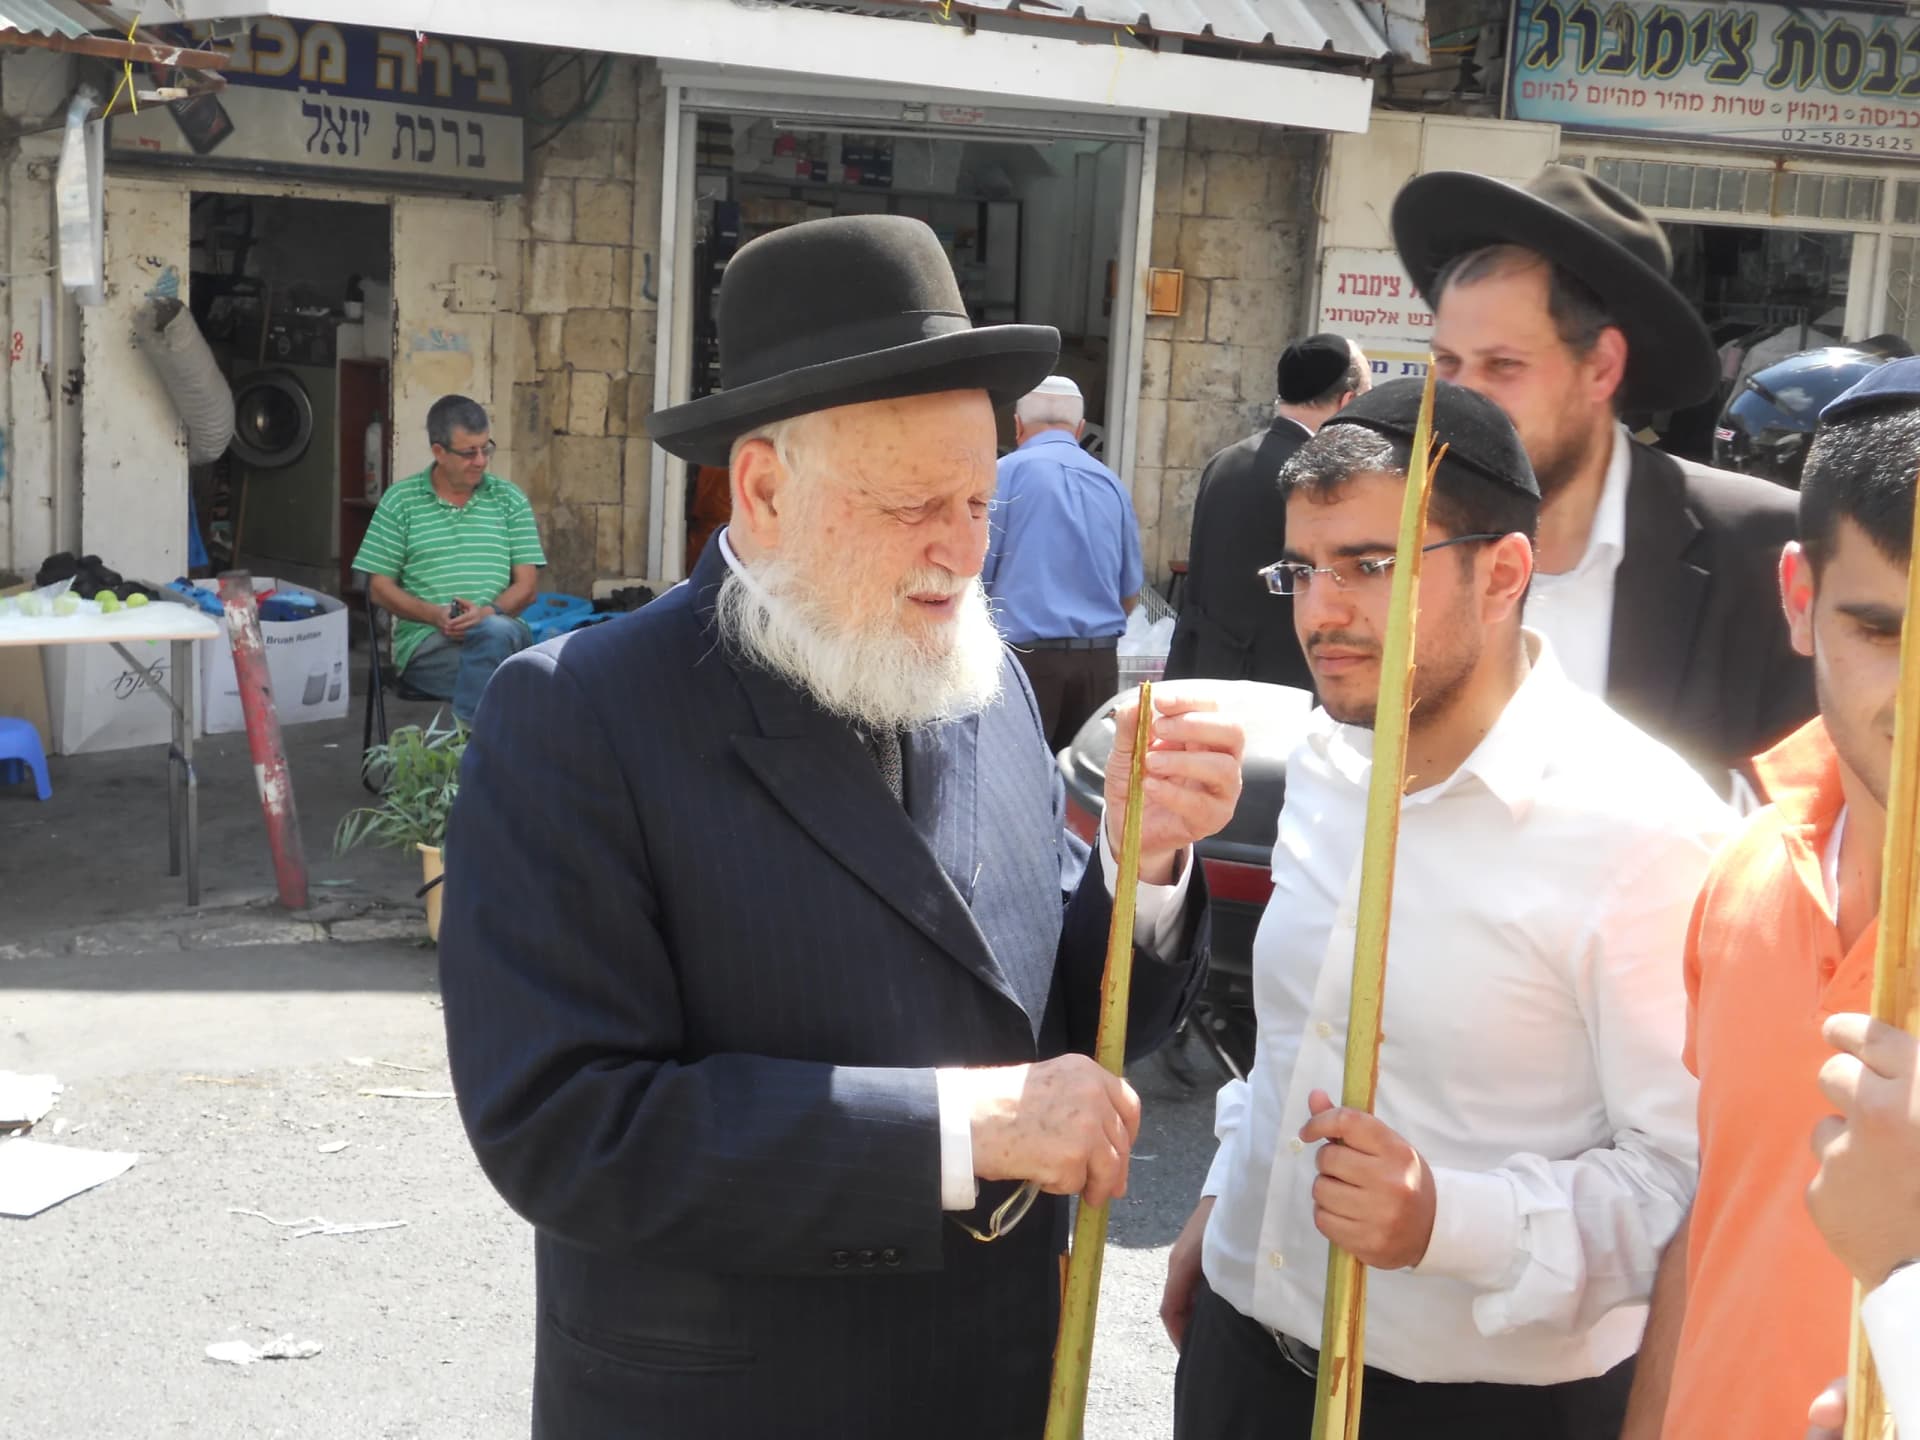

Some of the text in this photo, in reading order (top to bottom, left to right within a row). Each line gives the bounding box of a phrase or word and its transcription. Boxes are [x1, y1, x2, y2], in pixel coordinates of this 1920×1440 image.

[1527, 0, 1757, 83] צימברג
[376, 31, 512, 105] בירה
[1522, 78, 1579, 102] להיום
[1587, 84, 1646, 107] מהיום
[1654, 91, 1704, 111] מהיר
[1711, 95, 1765, 116] שרות
[1787, 101, 1838, 123] גיהוץ
[301, 98, 370, 157] יואל
[391, 112, 487, 168] ברכת
[1782, 128, 1913, 151] 02-5825425
[1337, 273, 1401, 297] צימברג
[1325, 307, 1434, 326] בש אלקטרוני
